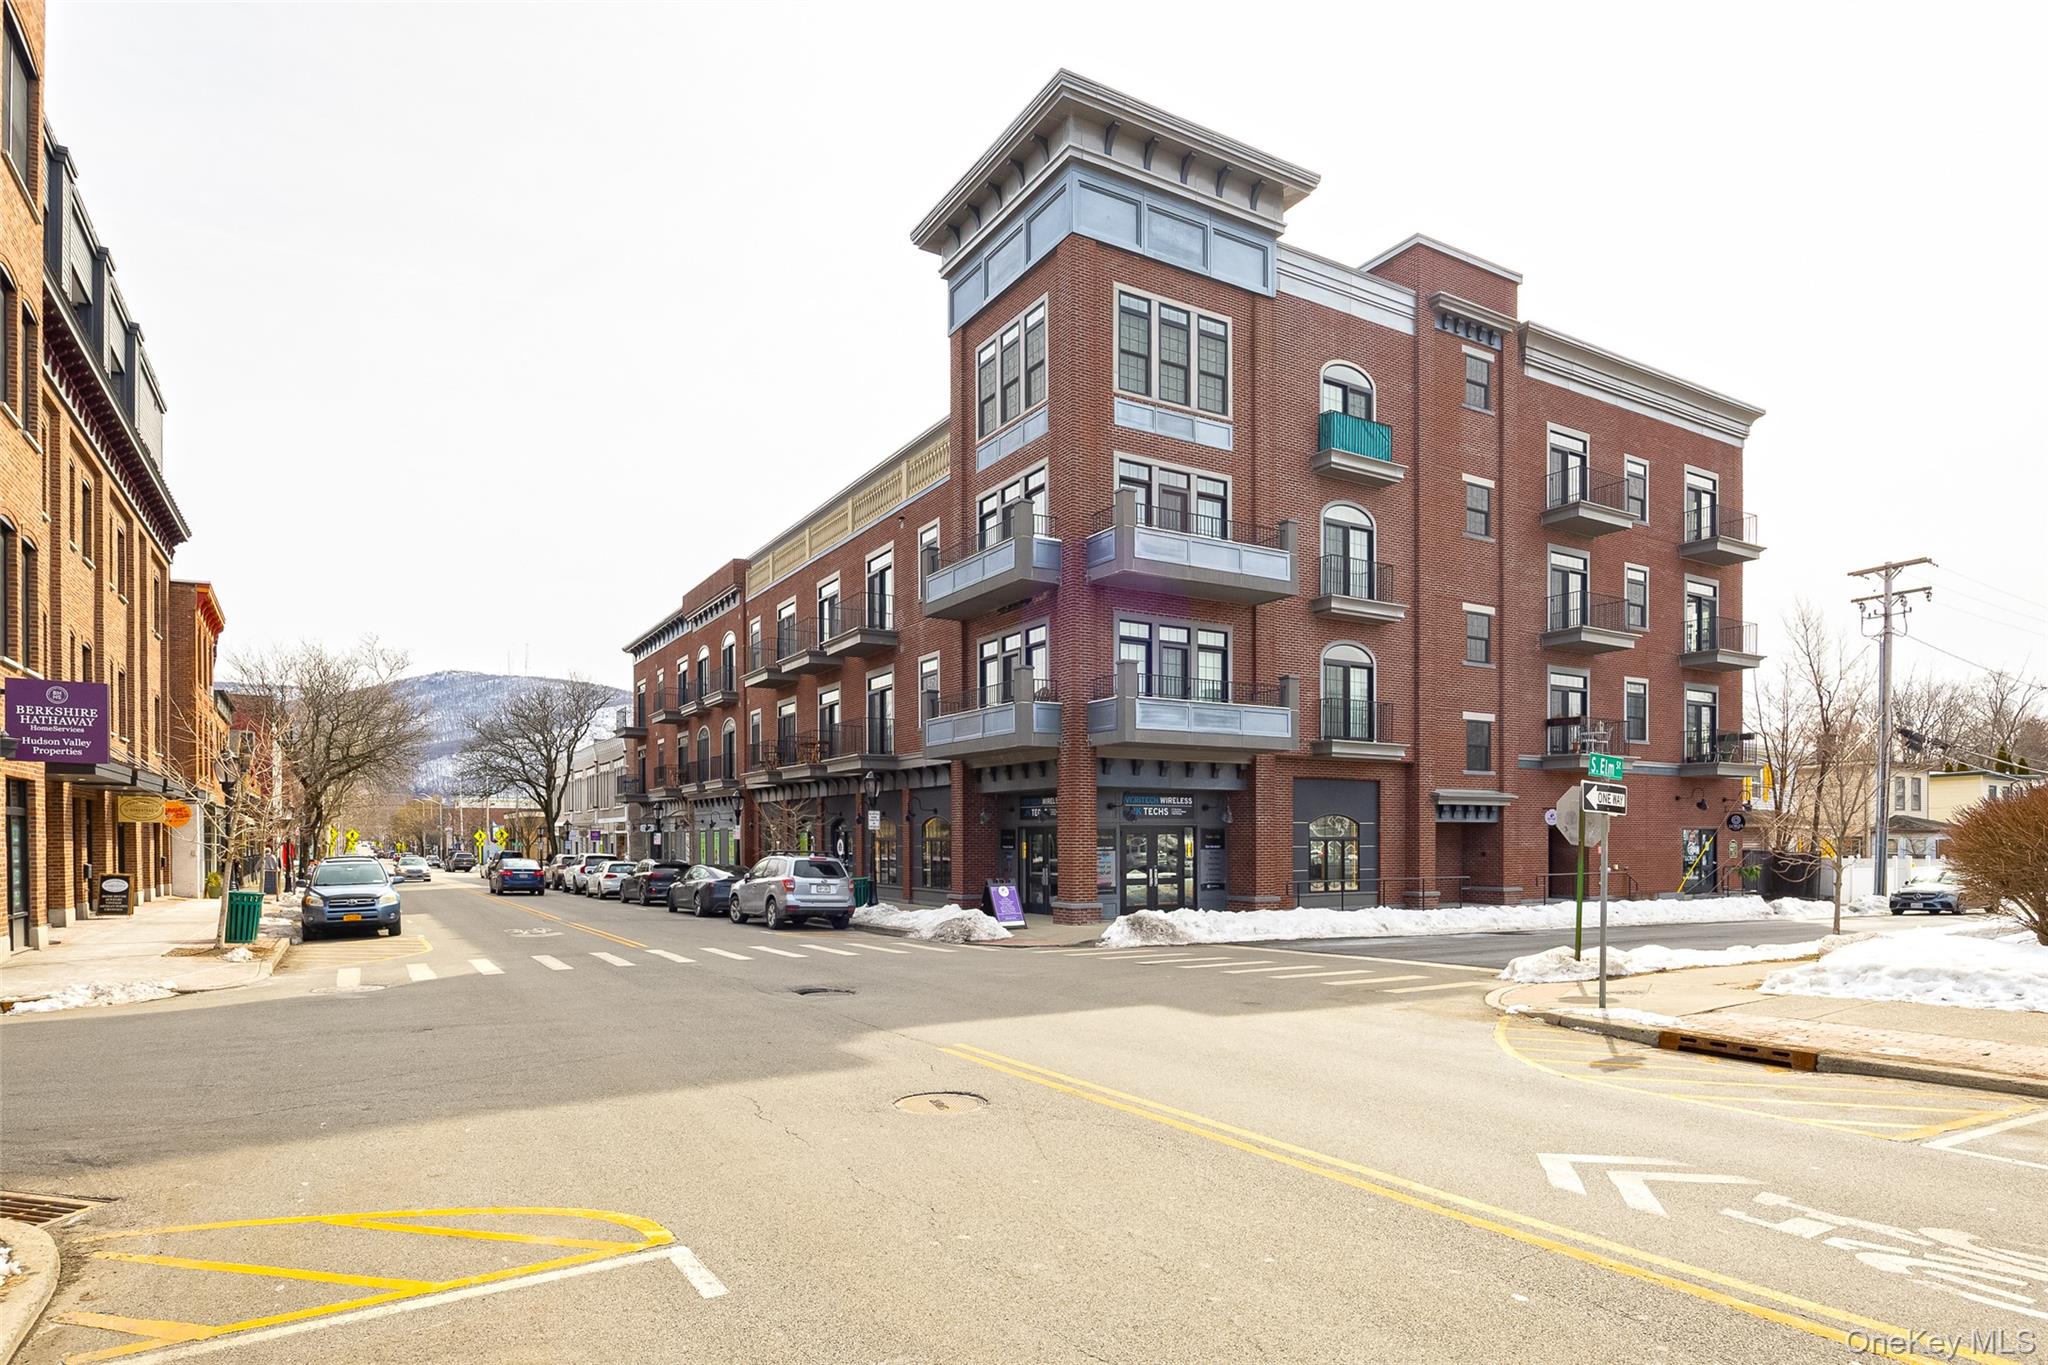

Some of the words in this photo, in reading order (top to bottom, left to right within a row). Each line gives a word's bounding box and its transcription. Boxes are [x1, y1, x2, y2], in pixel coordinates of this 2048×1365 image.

[16, 705, 98, 718] BERKSHIRE
[20, 715, 95, 727] HATHAWAY
[30, 725, 85, 733] HomeServices
[22, 737, 60, 746] Hudson
[62, 738, 92, 748] Valley
[32, 746, 83, 756] Properties
[1591, 756, 1599, 774] S.
[1600, 758, 1615, 777] Elm
[1160, 797, 1193, 805] WIRELESS
[1598, 792, 1611, 804] ONE
[1612, 794, 1624, 805] WAY
[1143, 807, 1169, 816] TECHS
